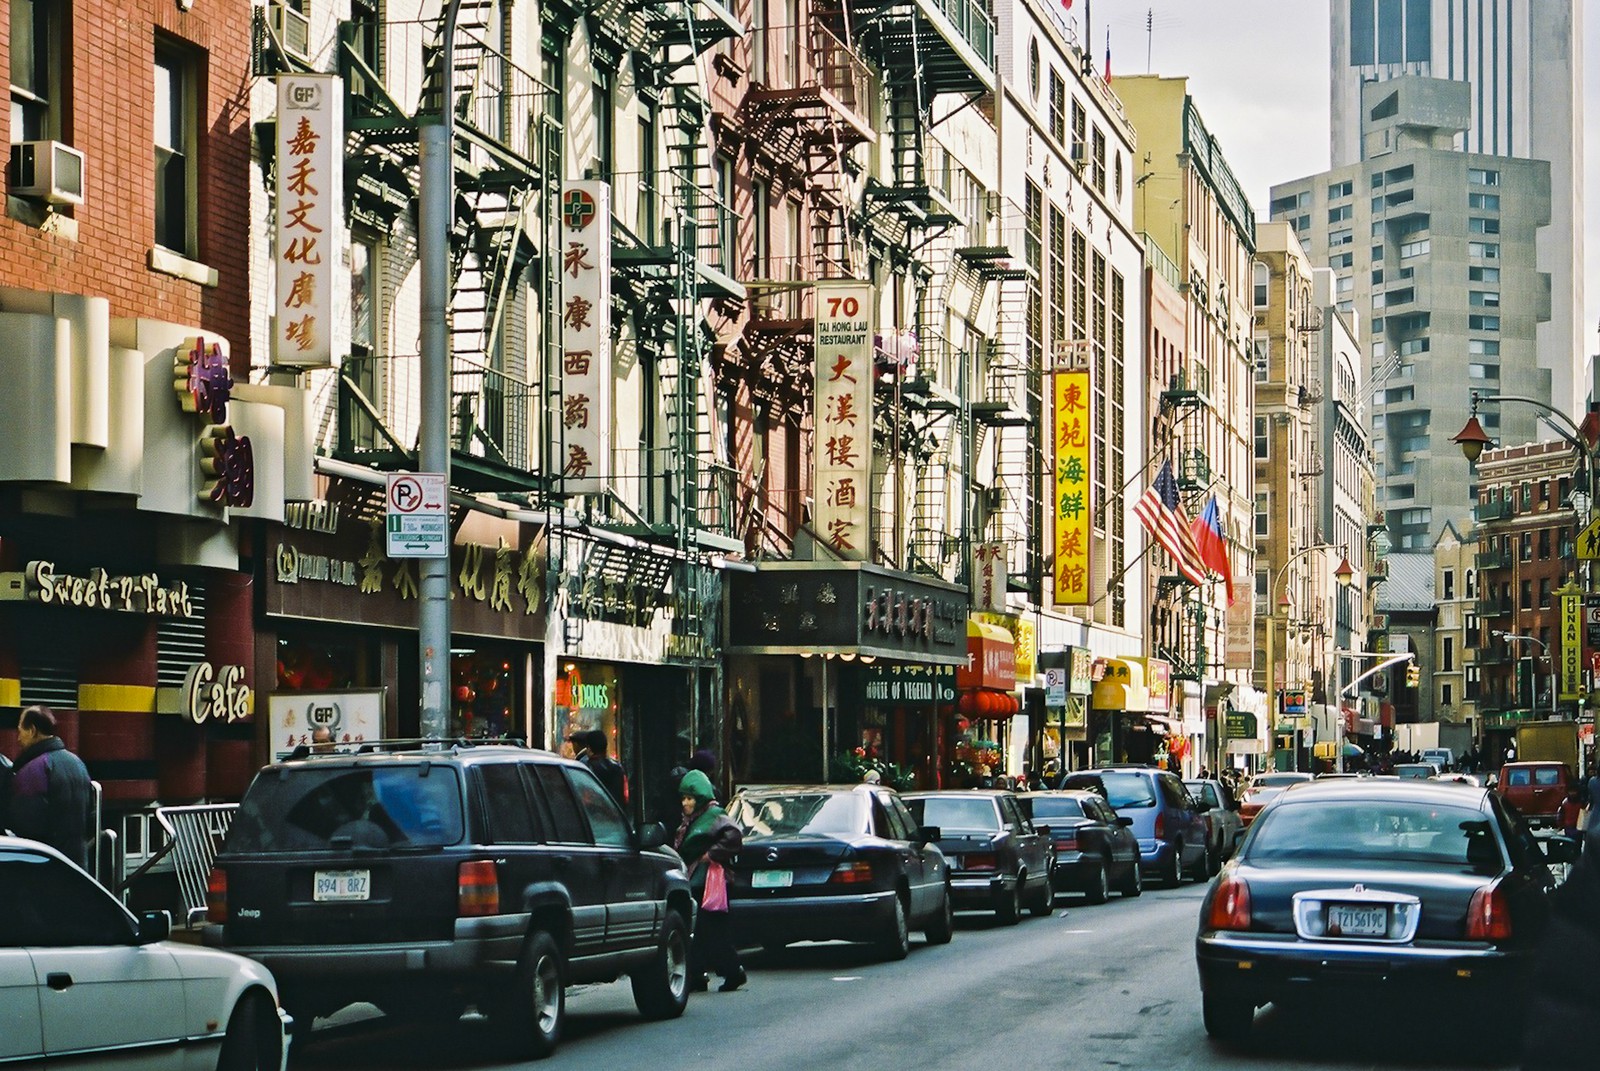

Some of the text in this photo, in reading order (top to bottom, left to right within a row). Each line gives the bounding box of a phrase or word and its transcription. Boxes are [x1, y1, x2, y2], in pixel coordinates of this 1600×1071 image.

[294, 86, 314, 103] GF
[827, 297, 859, 318] 70
[819, 321, 868, 333] TAI HONG LAU
[819, 334, 867, 346] RESTAURANT
[1057, 382, 1087, 594] 東苑海鮮菜館
[37, 560, 193, 617] Sweet-n-Tart
[1567, 597, 1576, 641] HUNAN
[579, 684, 609, 709] DRUGS
[866, 681, 888, 699] HOUSE
[891, 681, 901, 699] OF
[314, 707, 333, 723] GF
[317, 877, 367, 893] R94 8RZ
[237, 908, 261, 919] Jeep
